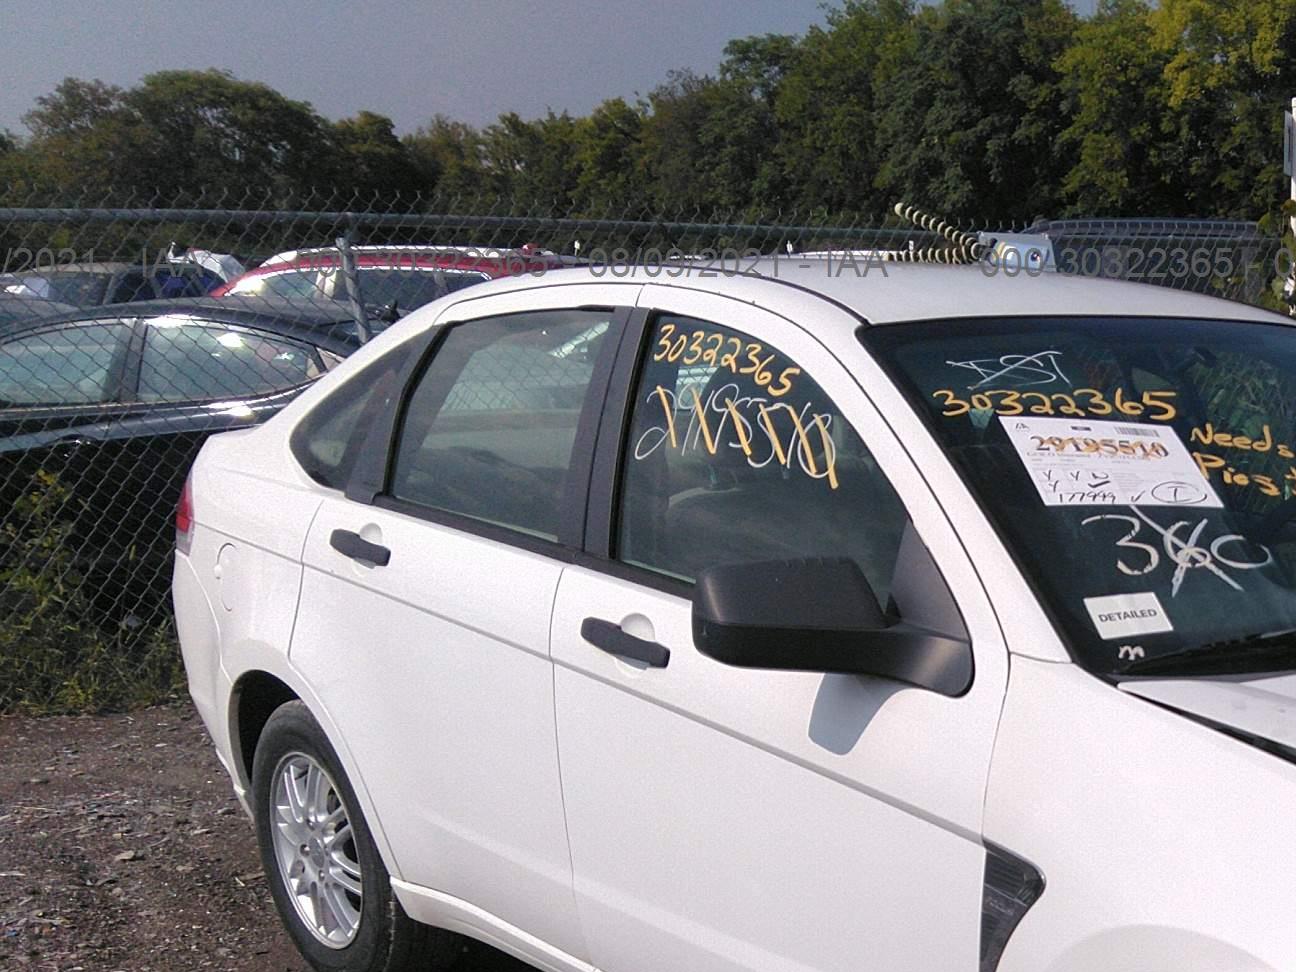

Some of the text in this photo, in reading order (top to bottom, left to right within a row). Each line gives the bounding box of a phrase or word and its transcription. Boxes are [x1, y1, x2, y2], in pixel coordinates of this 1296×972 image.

[653, 324, 800, 397] 30322365
[932, 387, 1177, 421] 30322365
[1190, 423, 1296, 459] Needs
[1097, 608, 1158, 623] DETAILED
